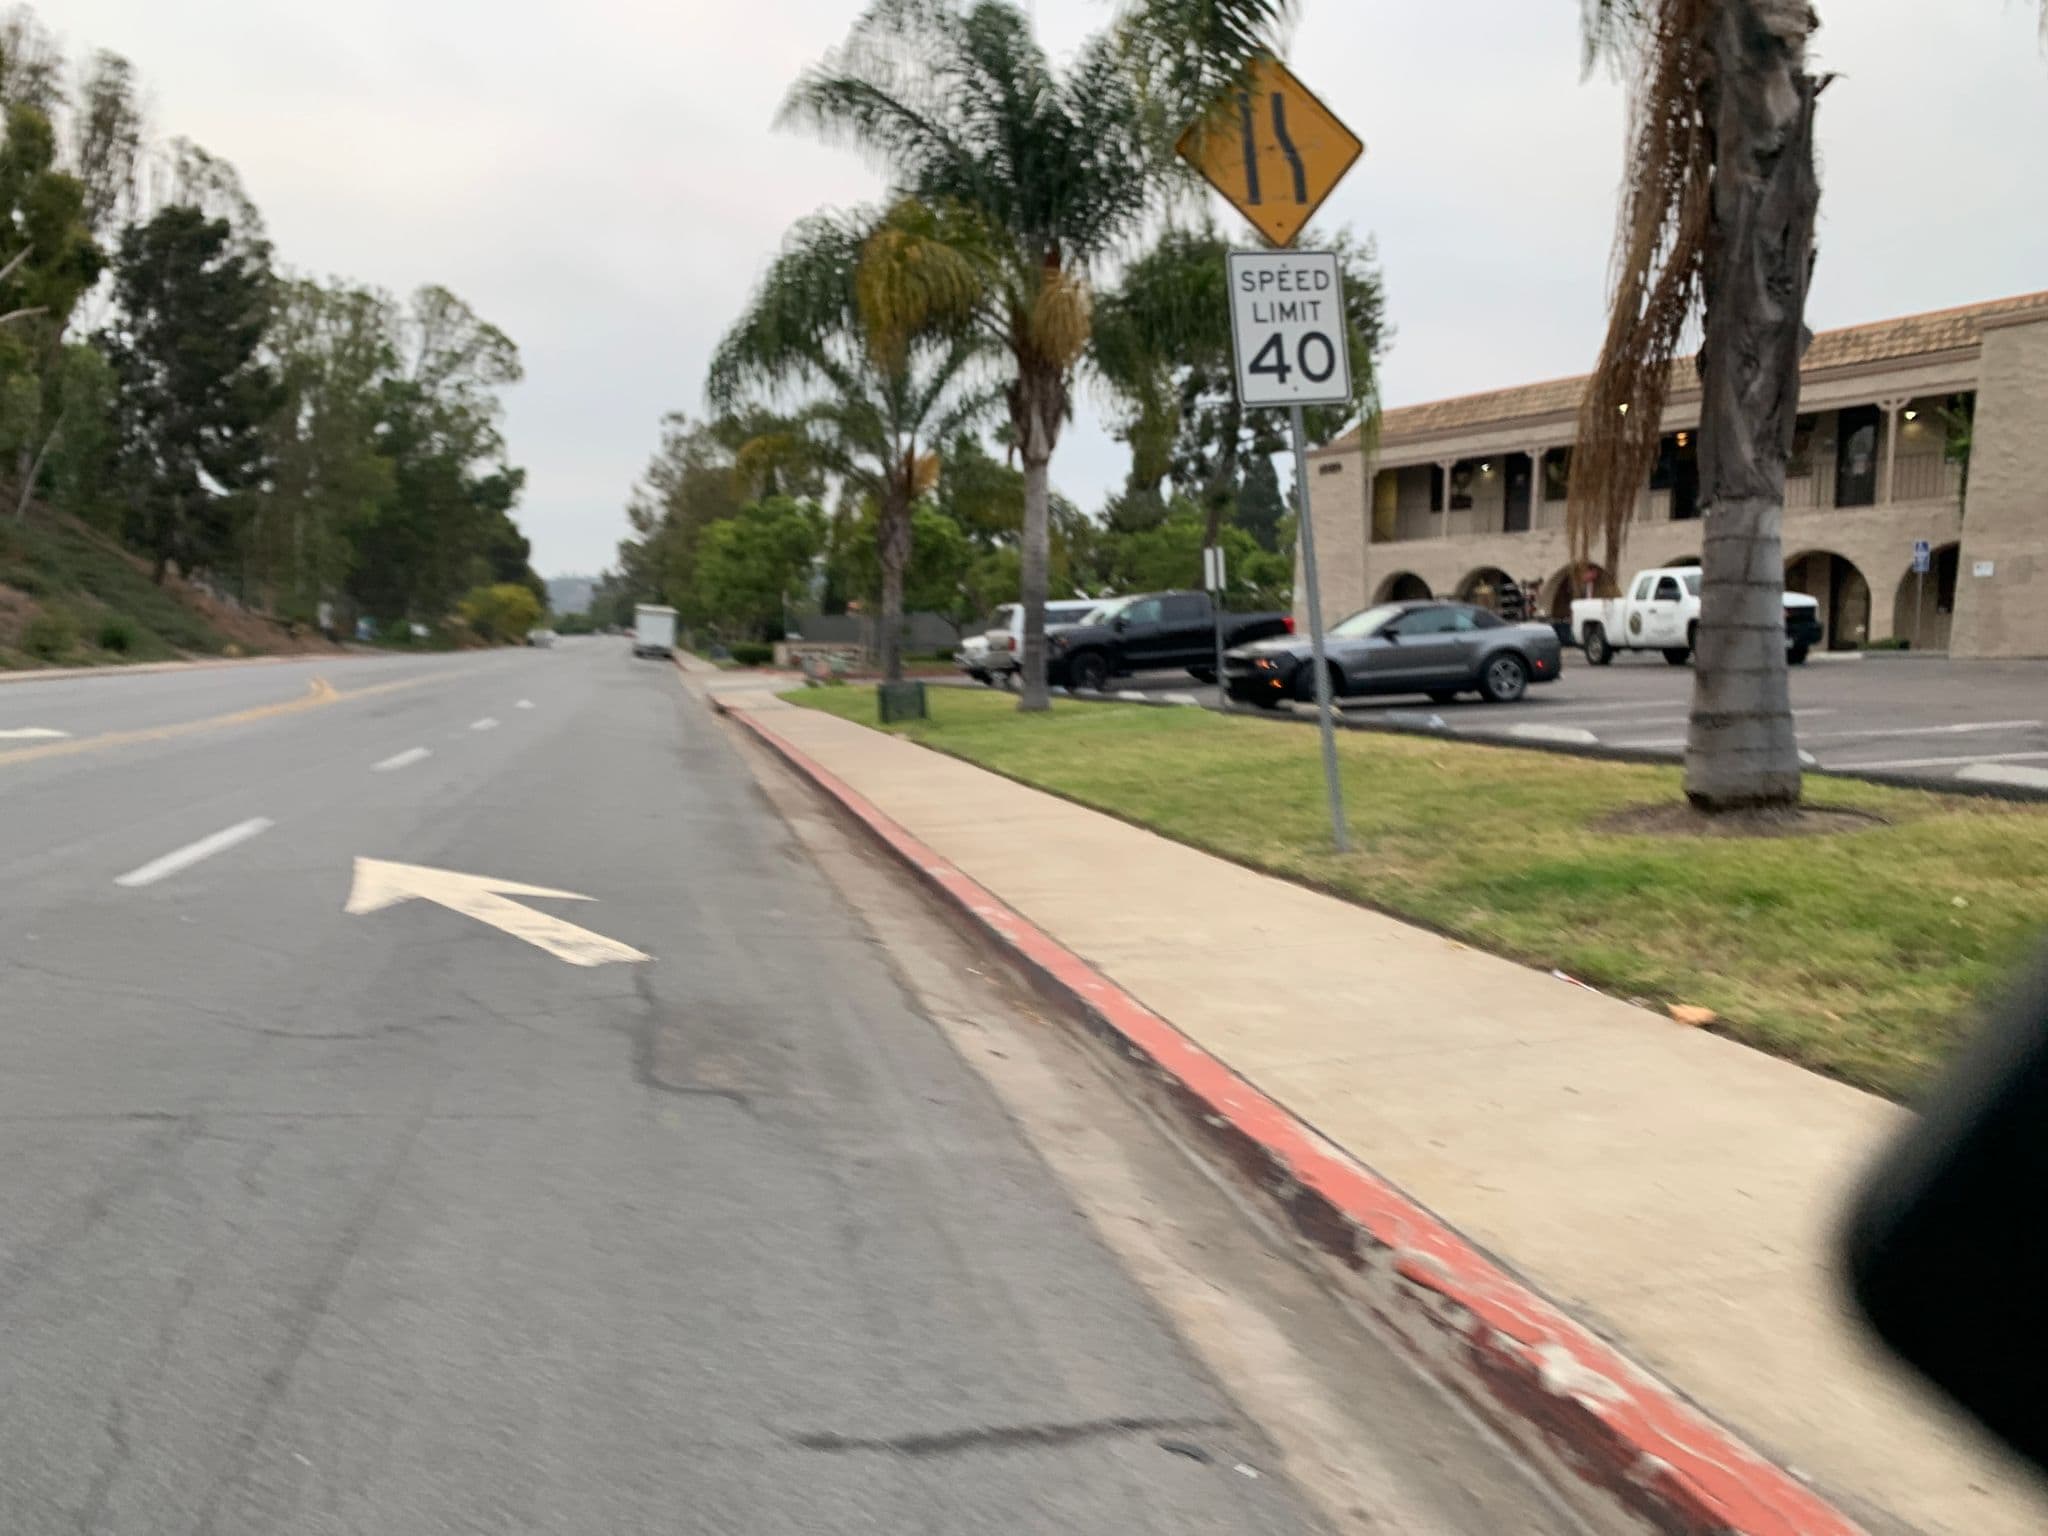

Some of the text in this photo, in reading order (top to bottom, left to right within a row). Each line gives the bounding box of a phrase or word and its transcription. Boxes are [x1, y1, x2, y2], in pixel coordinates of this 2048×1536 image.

[1241, 269, 1330, 292] SPEED
[1253, 301, 1321, 323] LIMIT
[1248, 331, 1336, 384] 40
